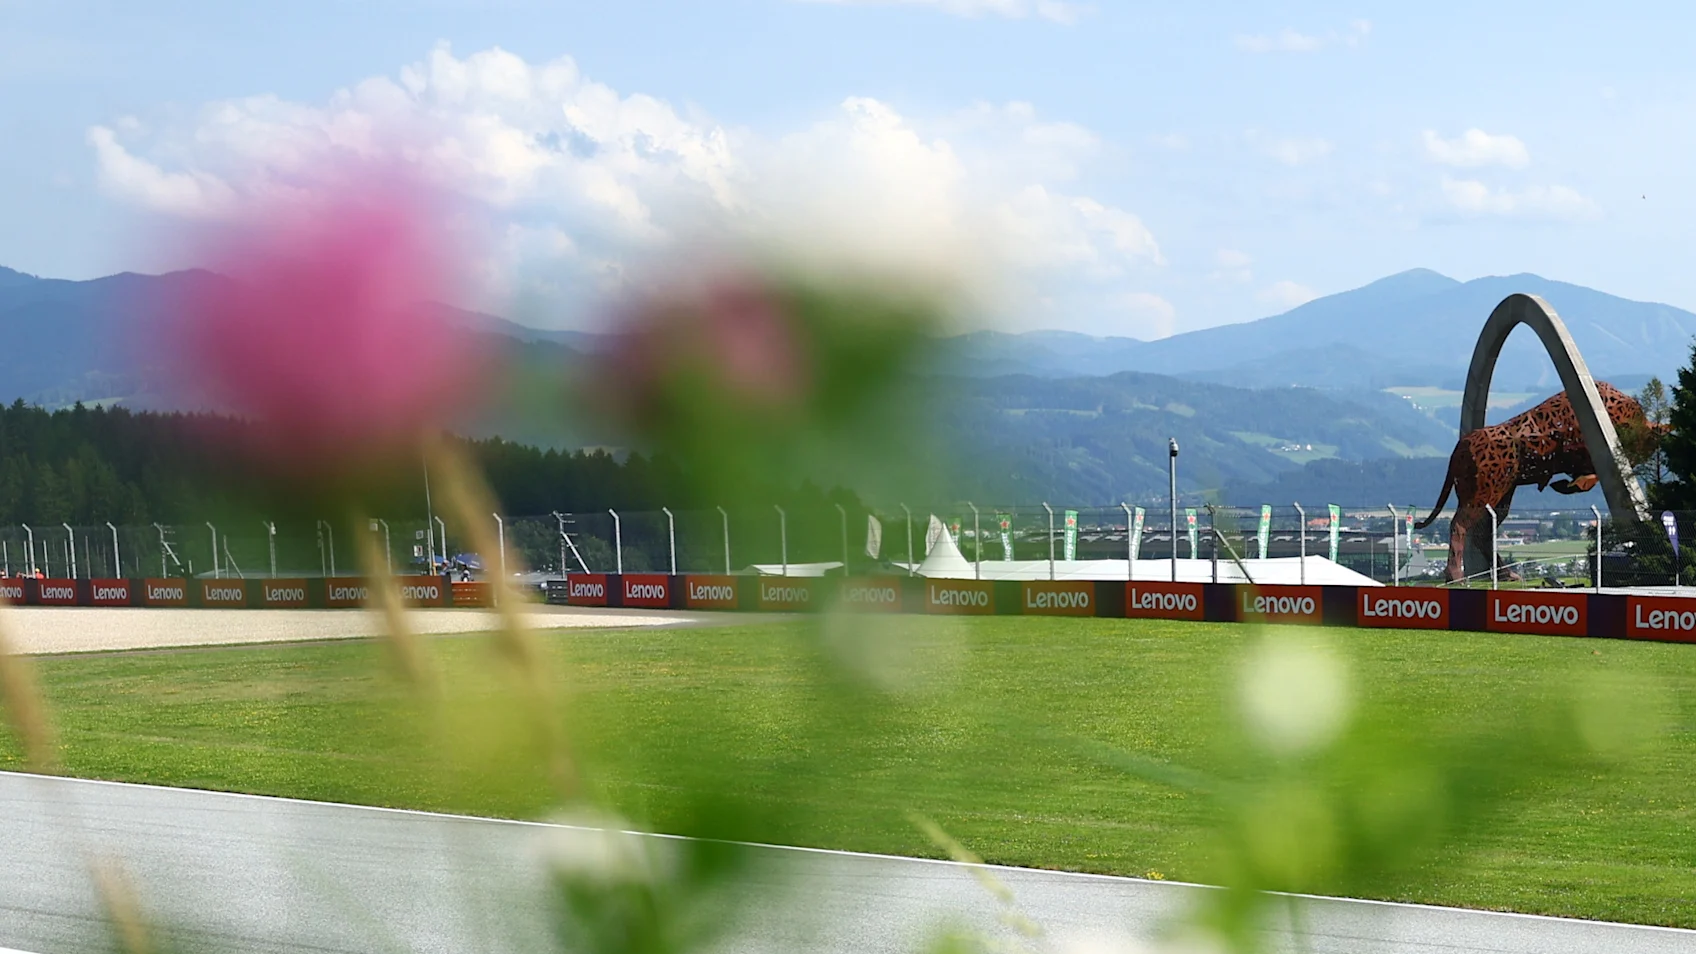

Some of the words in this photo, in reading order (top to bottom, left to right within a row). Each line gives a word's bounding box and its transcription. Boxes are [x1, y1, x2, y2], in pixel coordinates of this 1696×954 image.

[0, 585, 22, 598] novo
[41, 584, 73, 599] Lenovo
[93, 584, 127, 600] Lenovo
[148, 584, 183, 600] Lenovo
[205, 585, 242, 601] Lenovo
[265, 585, 304, 601] Lenovo
[402, 585, 438, 599] enovo
[569, 580, 604, 597] Lenovo
[626, 580, 665, 599] Lenovo
[690, 581, 733, 600] Lenovo
[761, 583, 809, 602] Lenovo
[931, 585, 989, 606] Lenovo
[1027, 588, 1088, 608] Lenovo
[1131, 588, 1197, 612] Lenovo
[1243, 590, 1315, 615] Lenovo
[1363, 592, 1441, 620] Lenovo
[1494, 599, 1579, 625] Lenovo
